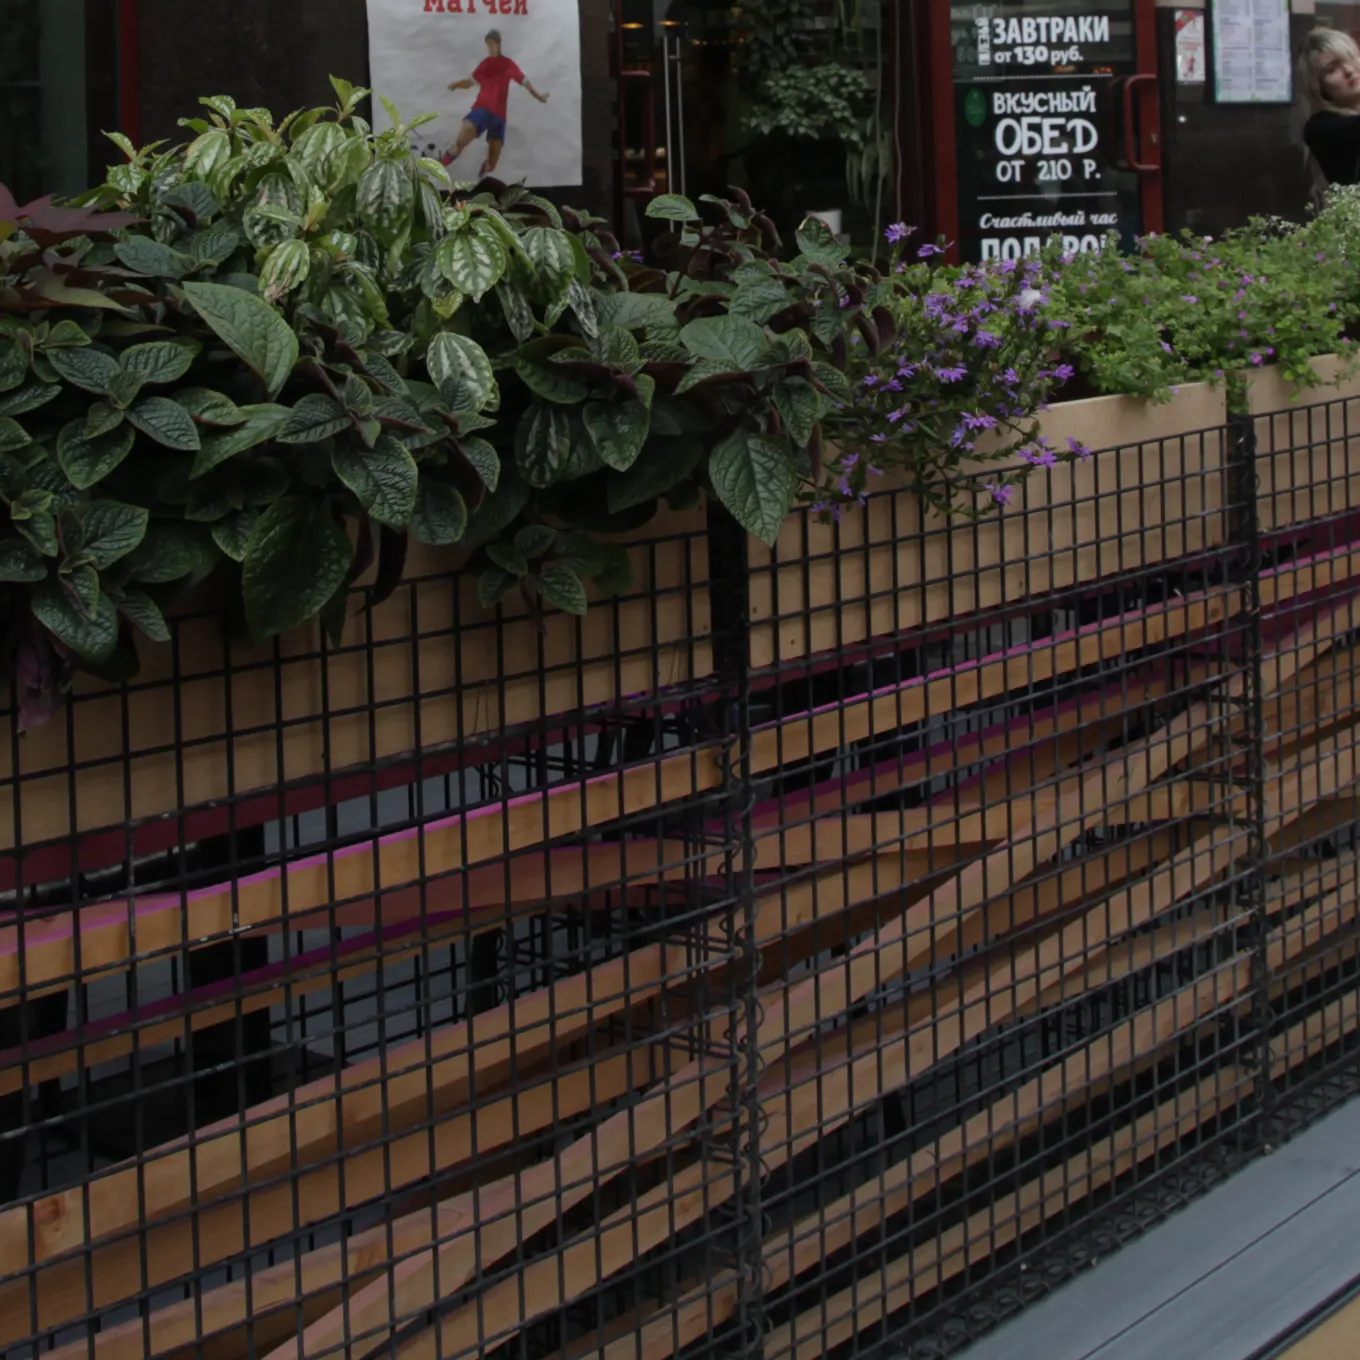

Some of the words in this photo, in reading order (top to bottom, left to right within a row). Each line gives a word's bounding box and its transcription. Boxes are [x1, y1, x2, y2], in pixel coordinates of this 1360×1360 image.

[993, 15, 1110, 44] ЗАВТРАКИ
[994, 50, 1012, 64] от
[1013, 46, 1049, 65] 130
[1050, 45, 1084, 67] руб.
[993, 86, 1097, 115] ВКУСНЫЙ
[995, 116, 1099, 156] ОБЕД
[996, 160, 1025, 182] ОТ
[1037, 159, 1072, 181] 210
[979, 210, 1086, 229] Счастливый
[1089, 211, 1118, 226] час
